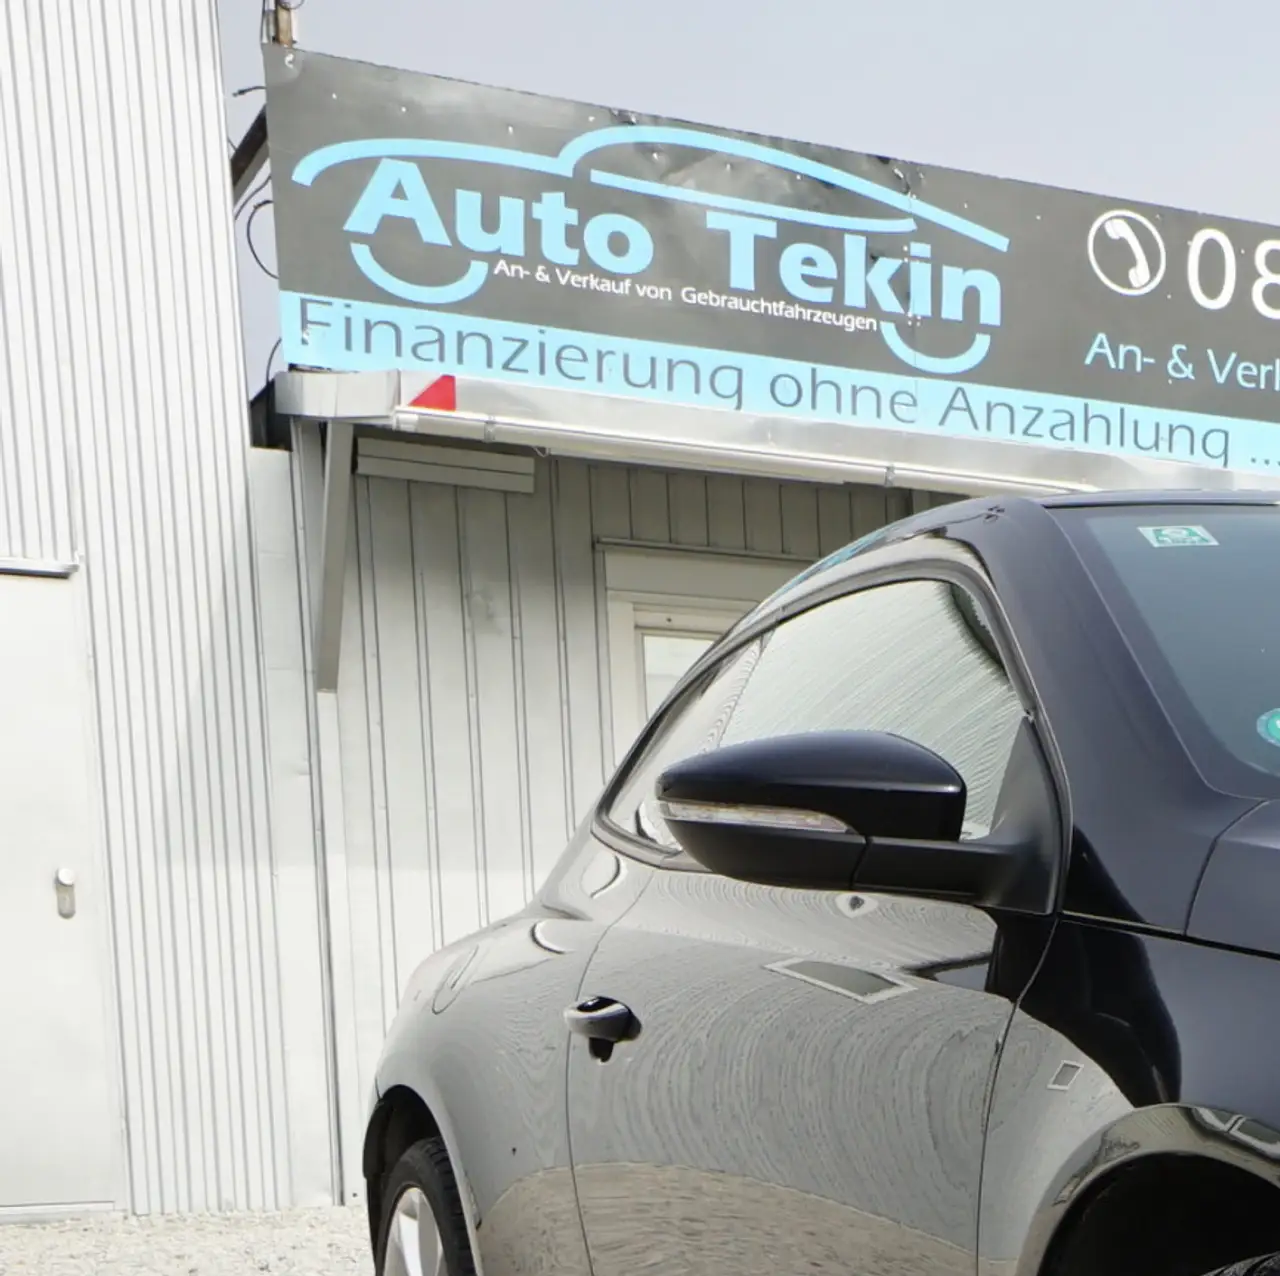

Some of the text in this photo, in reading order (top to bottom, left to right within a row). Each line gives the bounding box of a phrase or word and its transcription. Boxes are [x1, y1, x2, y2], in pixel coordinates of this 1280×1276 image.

[343, 157, 1002, 328] Auto Tekin
[493, 259, 879, 334] An- & Verkauf von Gebrauchtfahrzeugen
[298, 297, 745, 411] Finanzierung
[769, 368, 919, 426] ohne
[938, 386, 1230, 467] Anzahlung
[1085, 332, 1156, 373] An-
[1166, 344, 1196, 381] &
